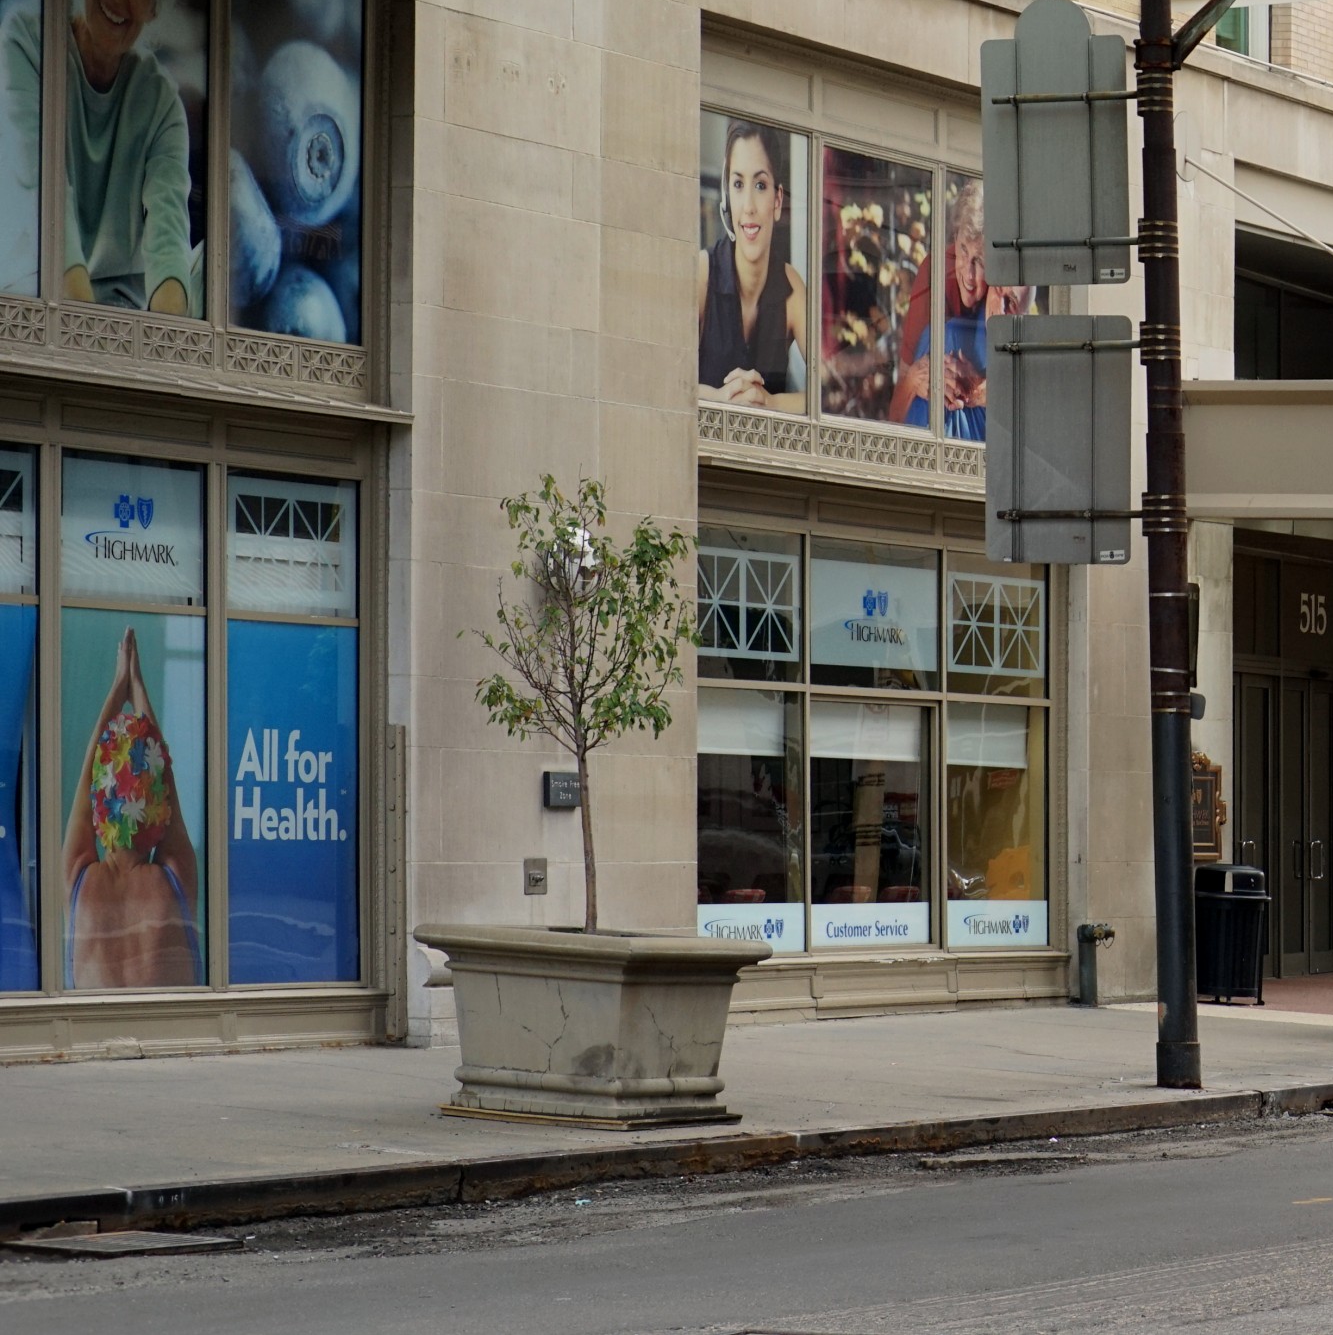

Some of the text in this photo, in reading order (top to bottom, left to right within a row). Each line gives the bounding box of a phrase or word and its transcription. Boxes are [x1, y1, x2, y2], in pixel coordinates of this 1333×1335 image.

[1299, 592, 1328, 636] 515
[235, 726, 333, 784] All for
[233, 785, 348, 842] Health.
[826, 918, 909, 940] Customer Service
